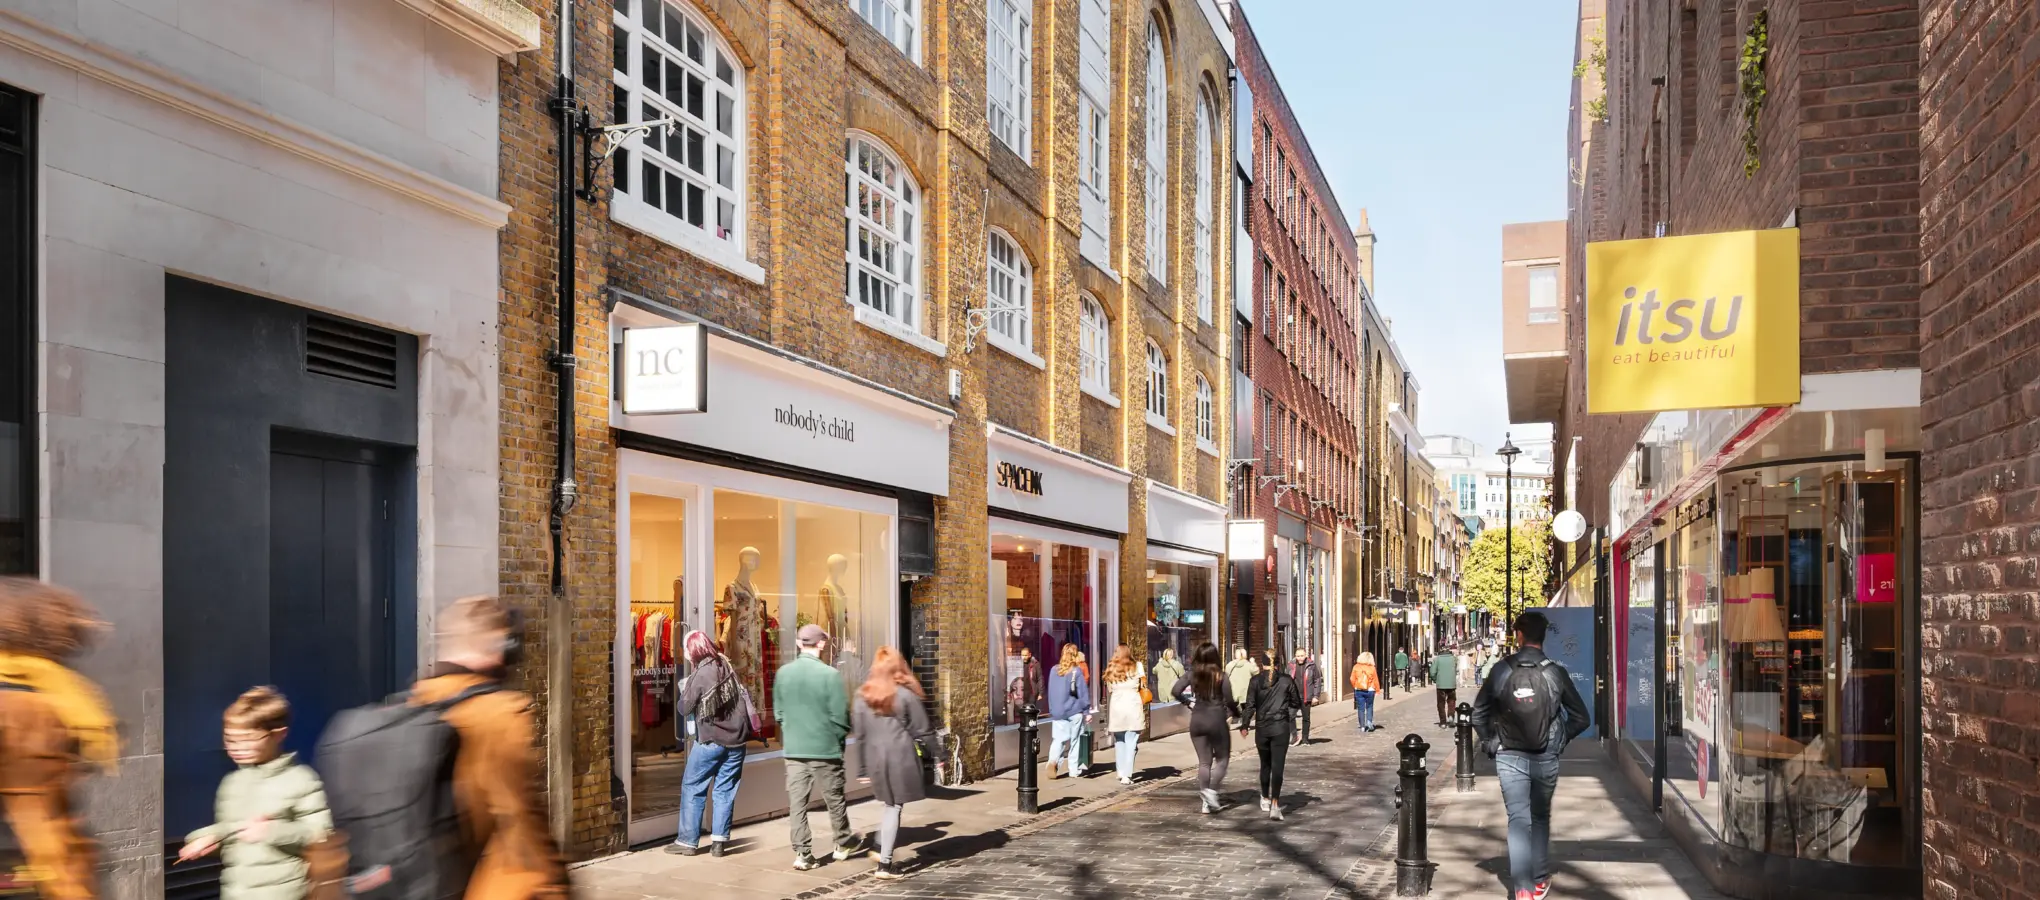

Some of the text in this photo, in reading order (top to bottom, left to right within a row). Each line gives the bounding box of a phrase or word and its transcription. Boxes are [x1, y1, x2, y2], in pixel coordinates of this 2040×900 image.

[1614, 286, 1744, 347] itsu
[637, 346, 684, 376] nc
[1612, 344, 1735, 365] eat beautiful
[775, 404, 854, 442] nobody's child
